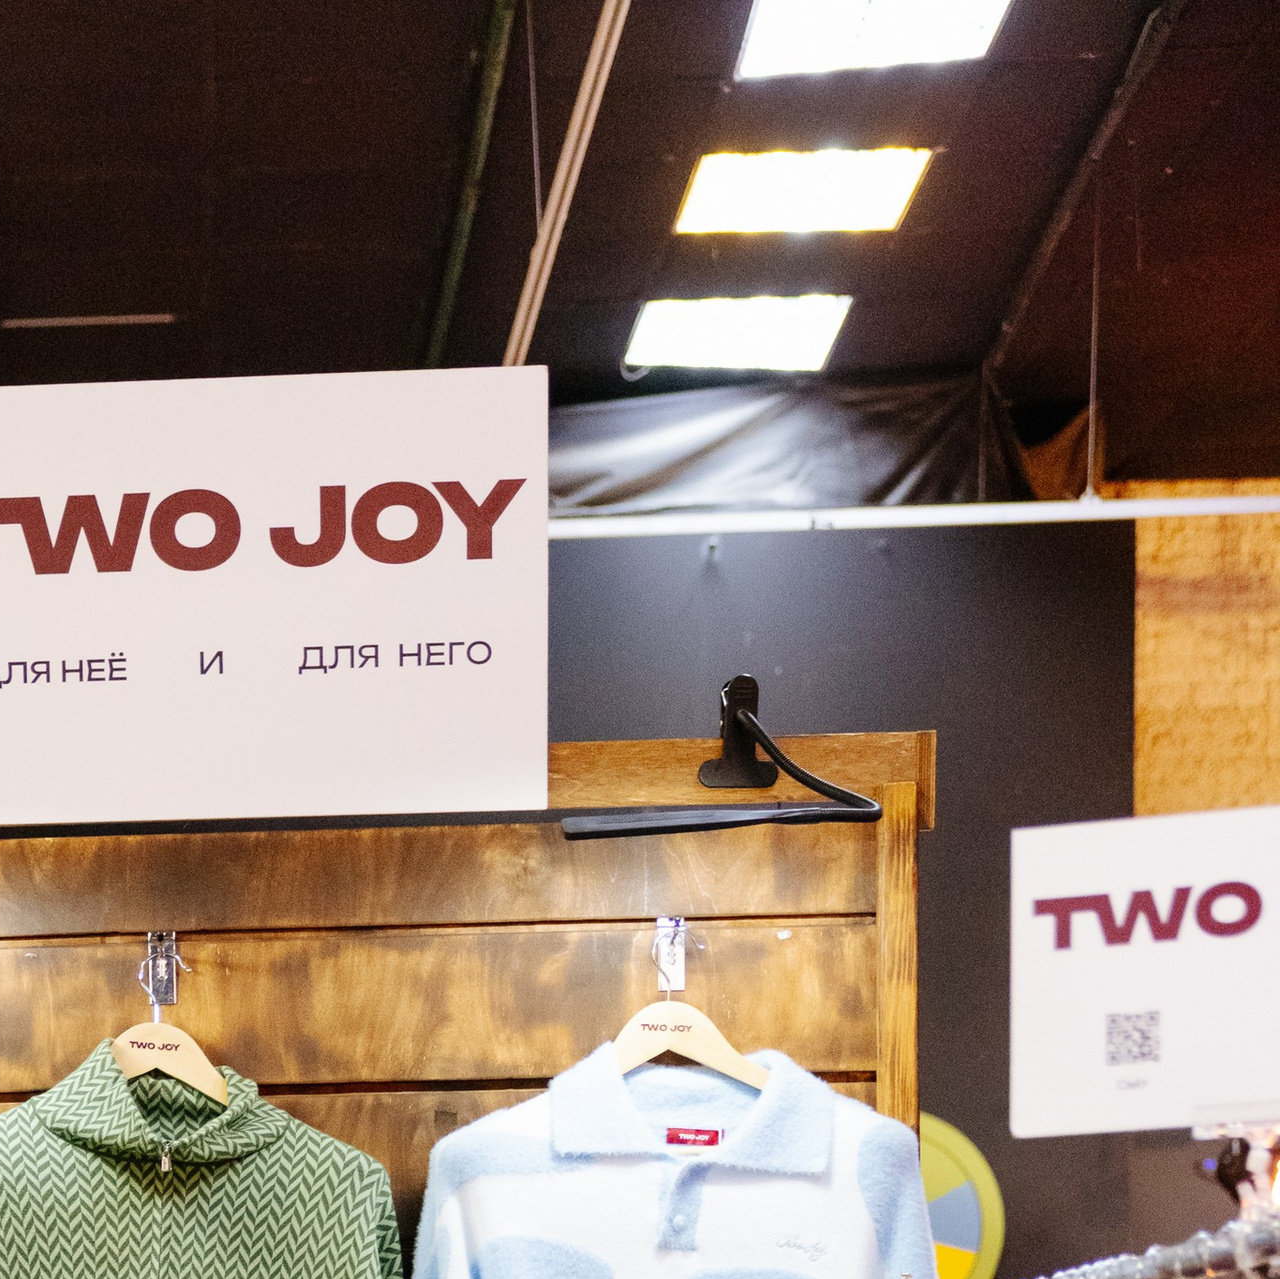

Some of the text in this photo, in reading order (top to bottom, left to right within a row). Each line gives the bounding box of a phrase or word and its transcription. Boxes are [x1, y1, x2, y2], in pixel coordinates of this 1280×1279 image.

[269, 478, 527, 568] JOY
[62, 652, 127, 683] НЕЁ
[199, 651, 224, 675] И
[299, 644, 379, 675] ДЛЯ
[399, 640, 492, 667] НЕГО
[1033, 881, 1262, 950] TWO
[129, 1040, 180, 1051] TWO JOY
[641, 1023, 692, 1032] TWO JOY
